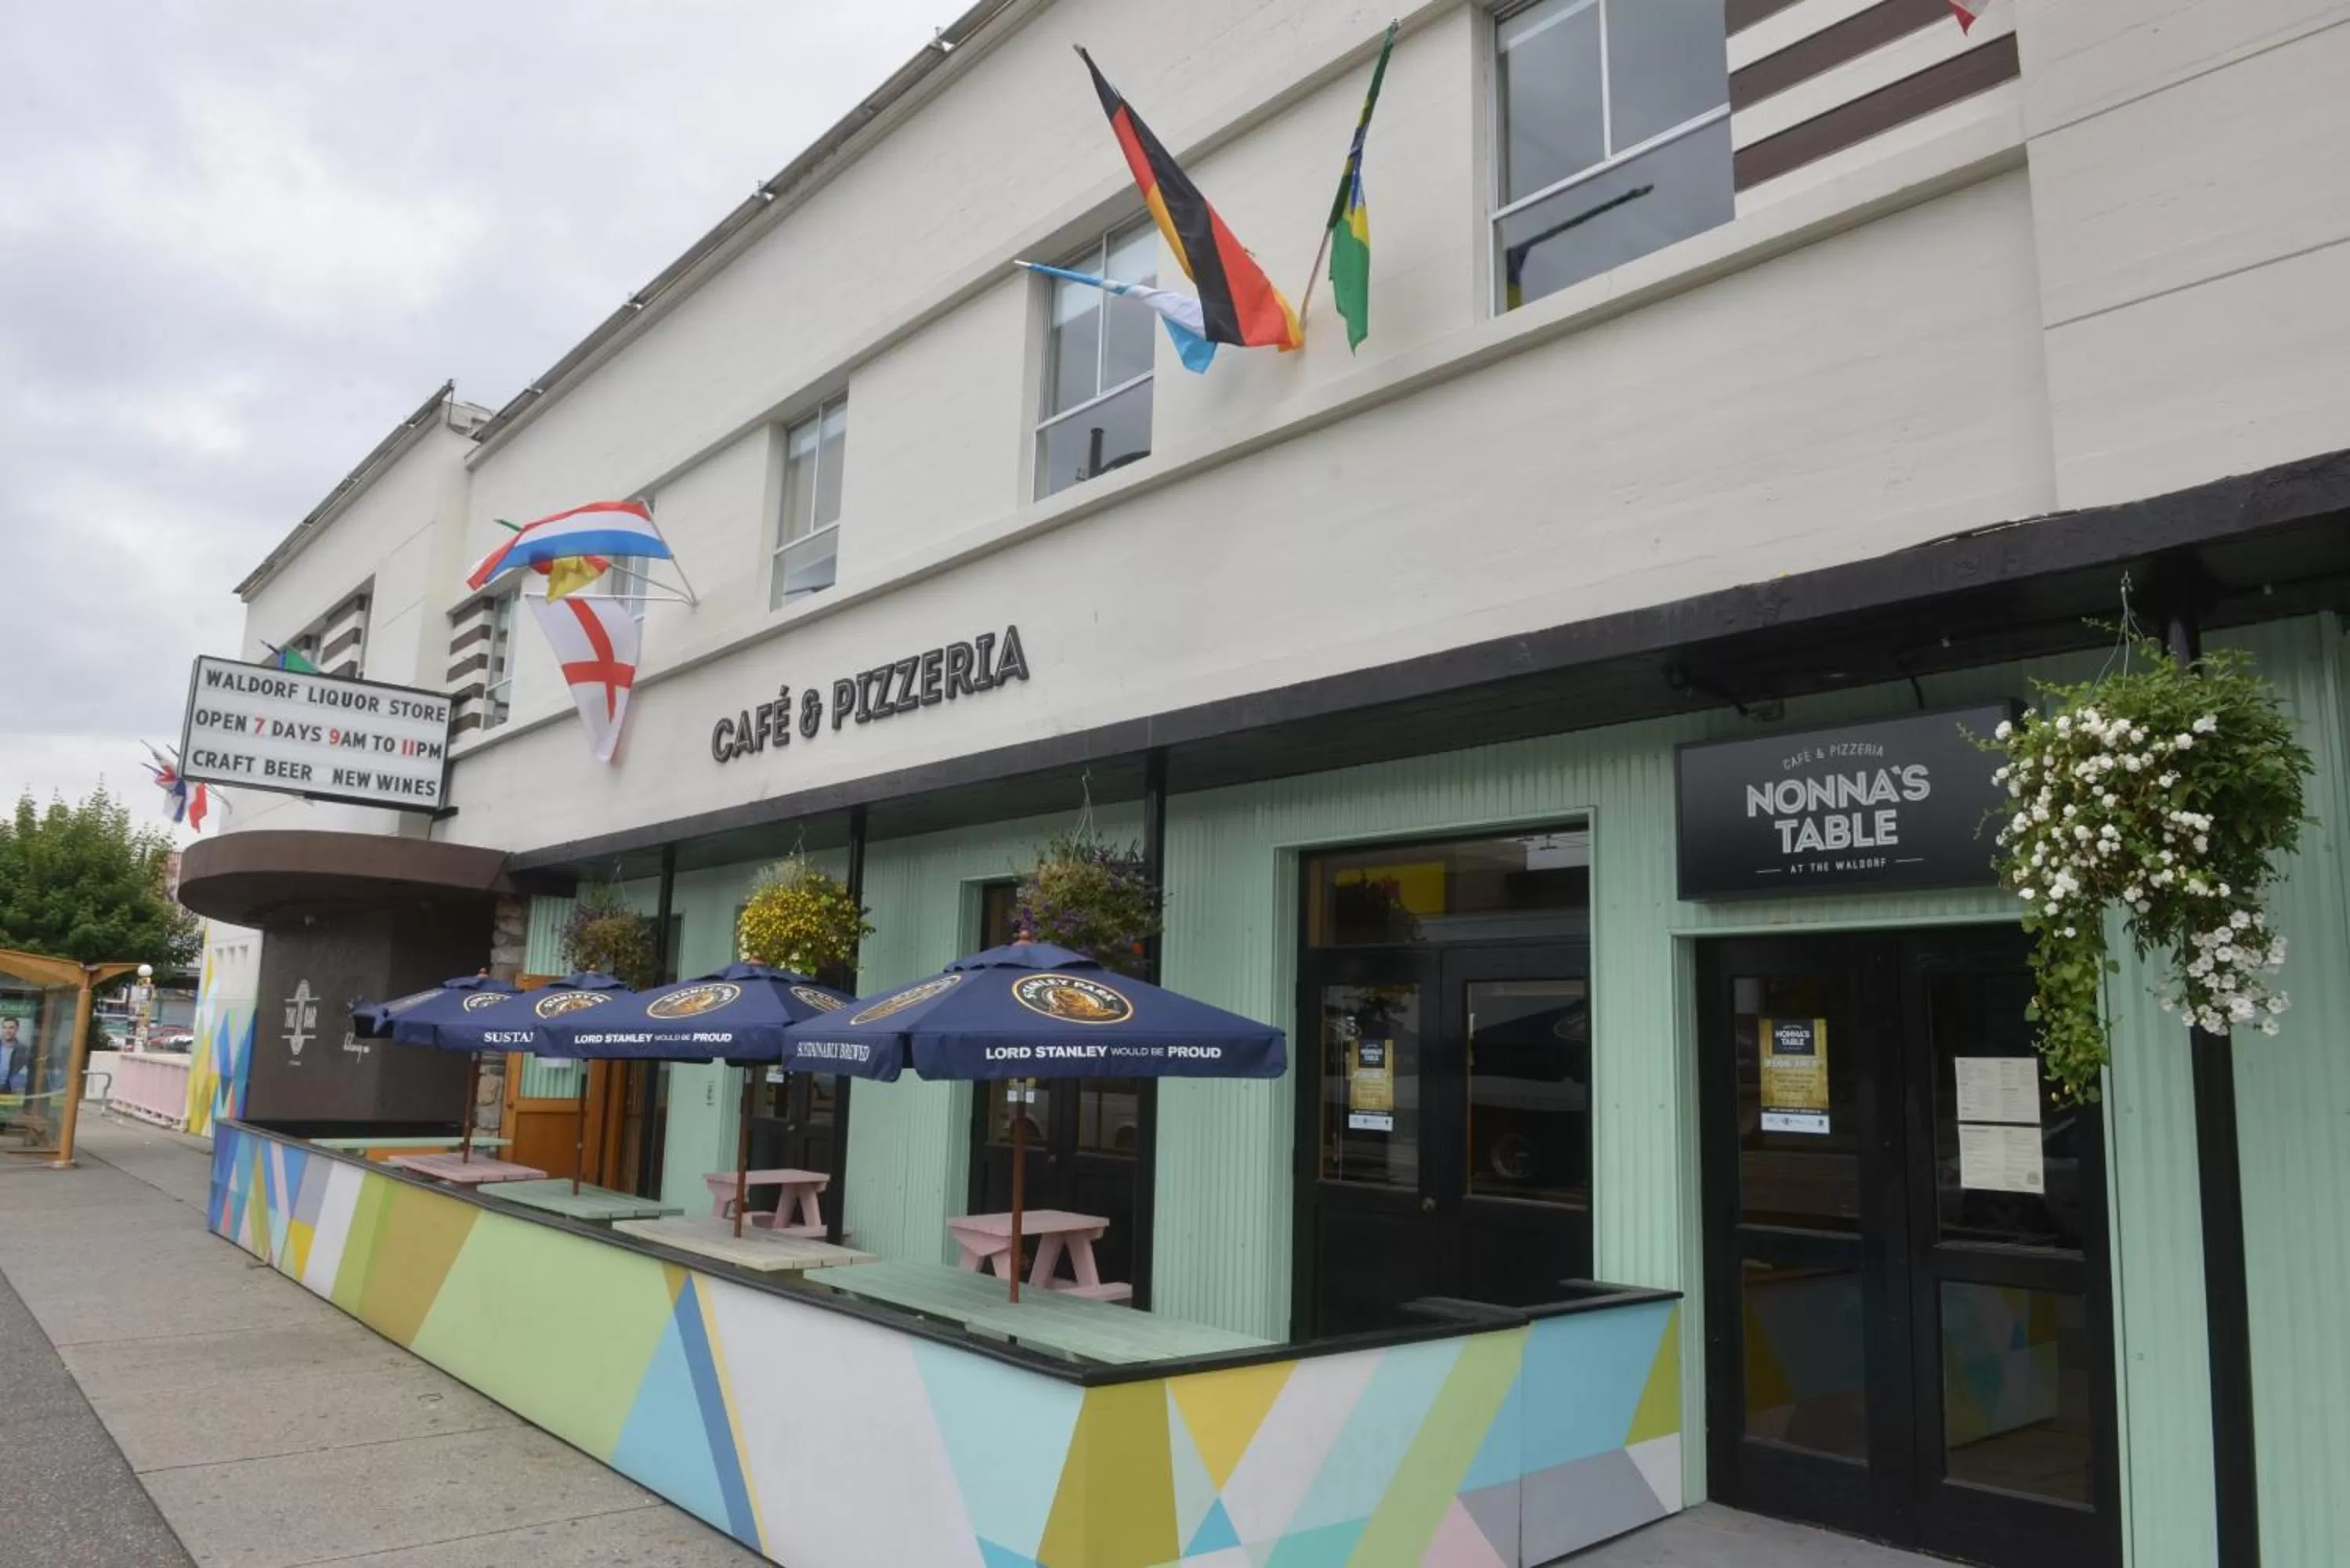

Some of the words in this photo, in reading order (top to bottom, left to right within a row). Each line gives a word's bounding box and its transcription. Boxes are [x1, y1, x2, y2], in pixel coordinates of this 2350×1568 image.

[206, 670, 299, 699] WALDORF
[307, 688, 380, 713] LIQUOR
[389, 699, 446, 723] STORE
[712, 685, 791, 763] CAFÉ
[799, 688, 822, 739] &
[831, 624, 1030, 730] PIZZERIA
[196, 709, 248, 734] OPEN
[254, 717, 266, 735] 7
[272, 719, 323, 742] DAYS
[328, 728, 366, 750] 9AM
[373, 735, 396, 753] TO
[401, 739, 443, 759] 11PM
[1829, 743, 1883, 757] PIZZERIA
[192, 750, 256, 773] CRAFT
[264, 758, 313, 782] BEER
[332, 768, 371, 788] NEW
[376, 773, 437, 797] WINES
[1746, 764, 1931, 818] NONNA'S
[1774, 809, 1899, 854] TABLE
[1790, 864, 1804, 874] AT
[1810, 862, 1829, 873] THE
[1835, 858, 1886, 871] WALDORF
[574, 1034, 602, 1044] LORD
[604, 1033, 654, 1043] STANLEY
[692, 1032, 732, 1042] PROUD
[985, 1047, 1032, 1060] LORD
[1035, 1046, 1108, 1058] STANLEY
[1110, 1047, 1148, 1057] WOULD
[1151, 1047, 1164, 1056] BE
[1168, 1046, 1222, 1058] PROUD
